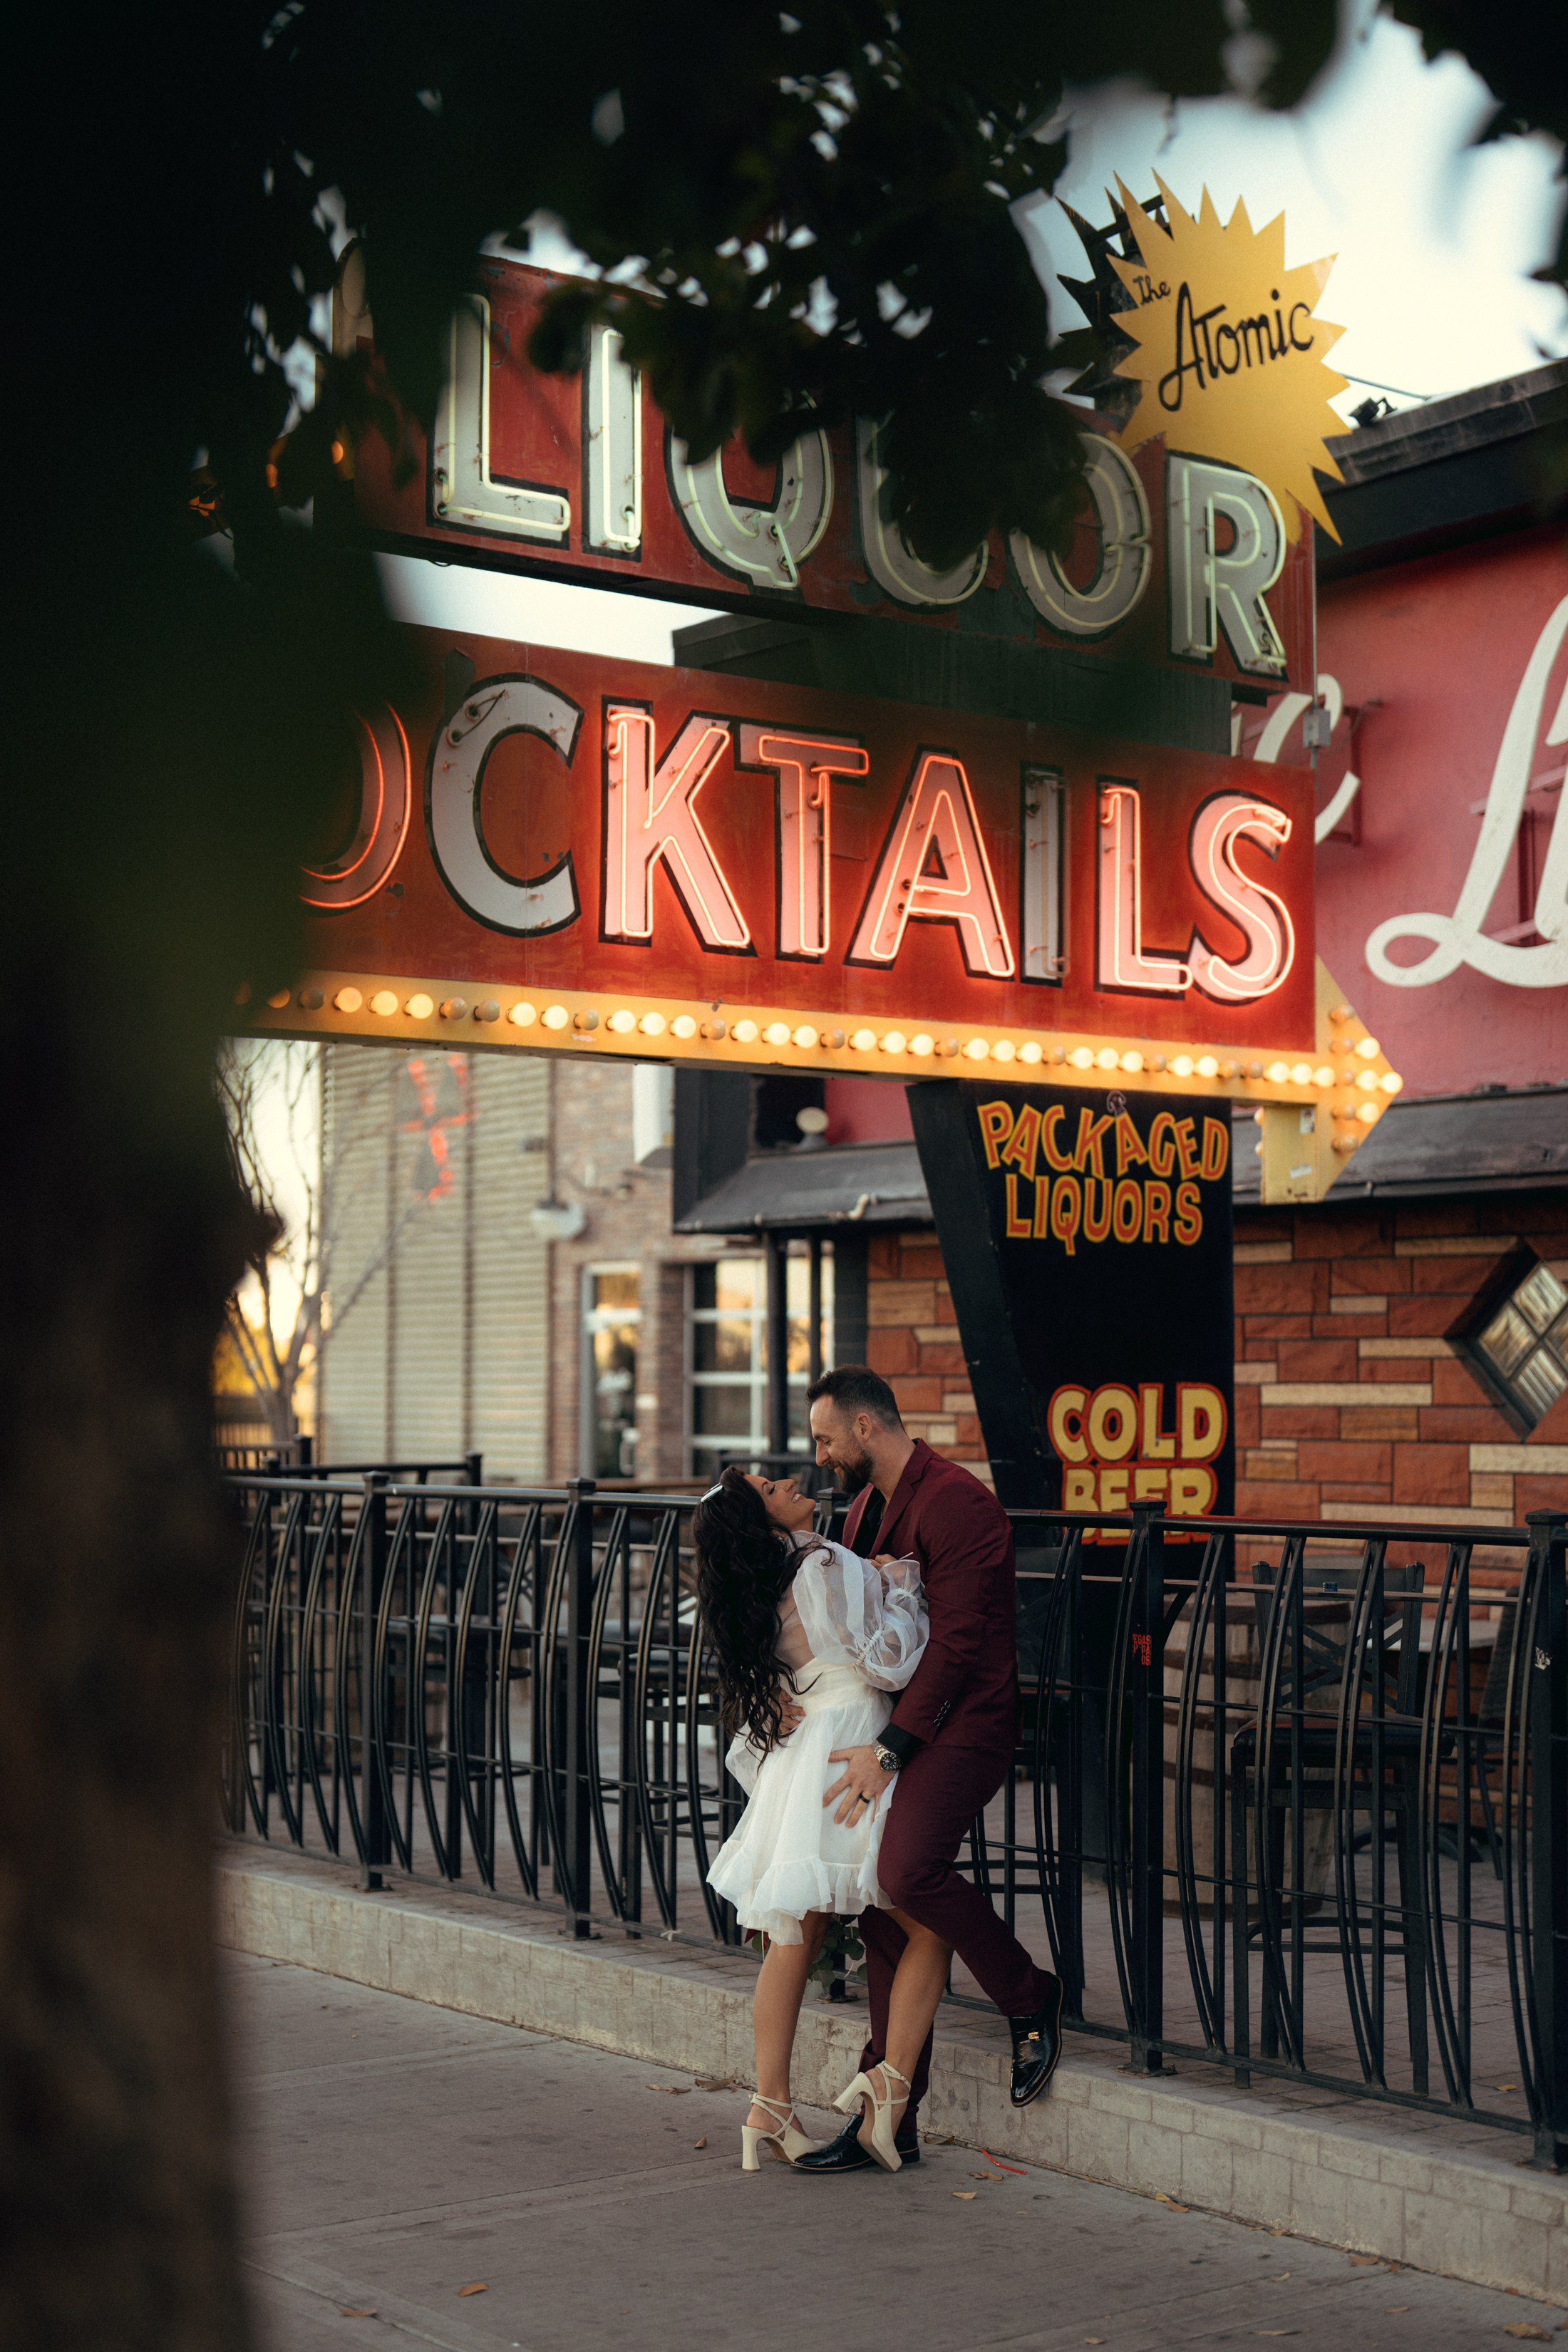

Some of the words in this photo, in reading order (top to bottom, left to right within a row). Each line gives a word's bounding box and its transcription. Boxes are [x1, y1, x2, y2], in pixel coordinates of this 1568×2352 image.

[1158, 281, 1314, 412] Atomic
[976, 1100, 1229, 1182] PACKAGED
[1005, 1172, 1203, 1256] LIQUORS
[1046, 1381, 1228, 1464] COLD
